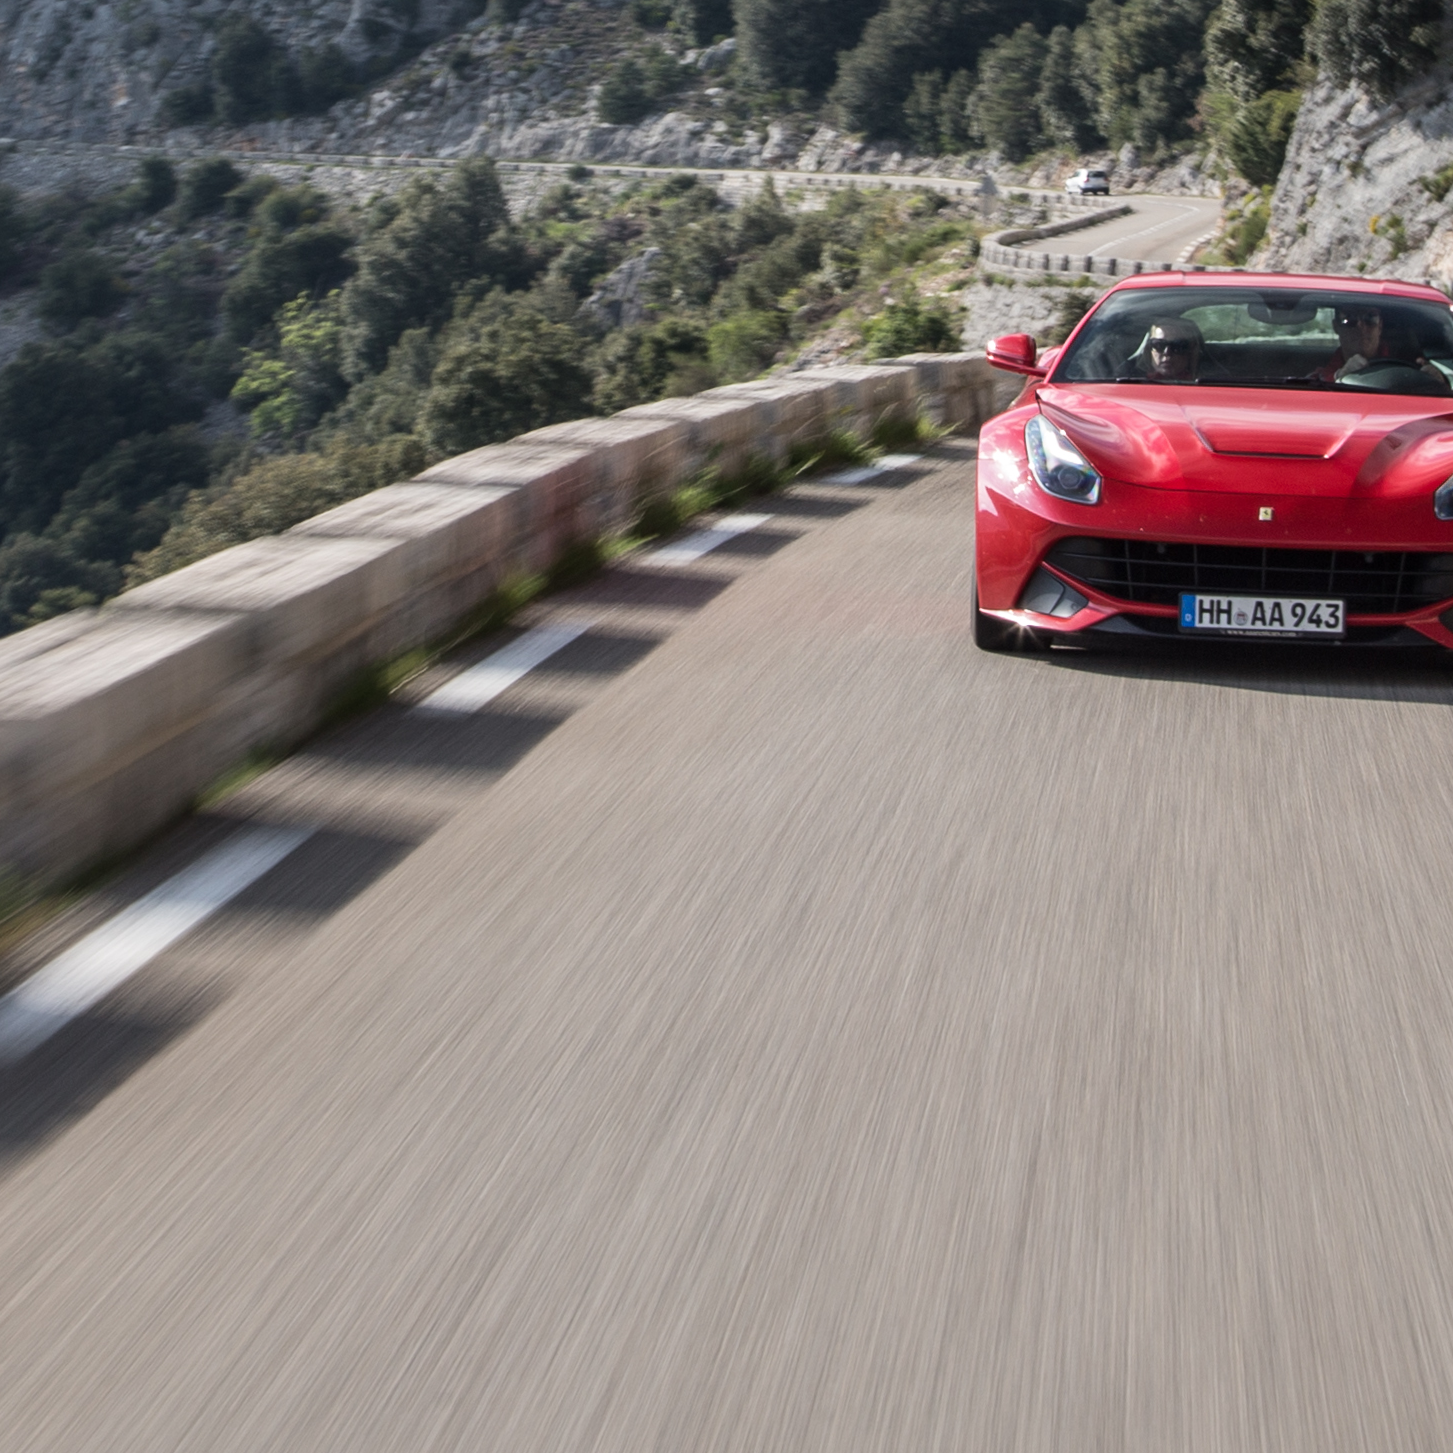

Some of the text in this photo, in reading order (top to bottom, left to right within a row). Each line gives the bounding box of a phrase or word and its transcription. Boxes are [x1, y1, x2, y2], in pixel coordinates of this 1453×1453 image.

[1198, 599, 1233, 625] HH
[1250, 601, 1285, 627] AA
[1291, 602, 1340, 629] 943
